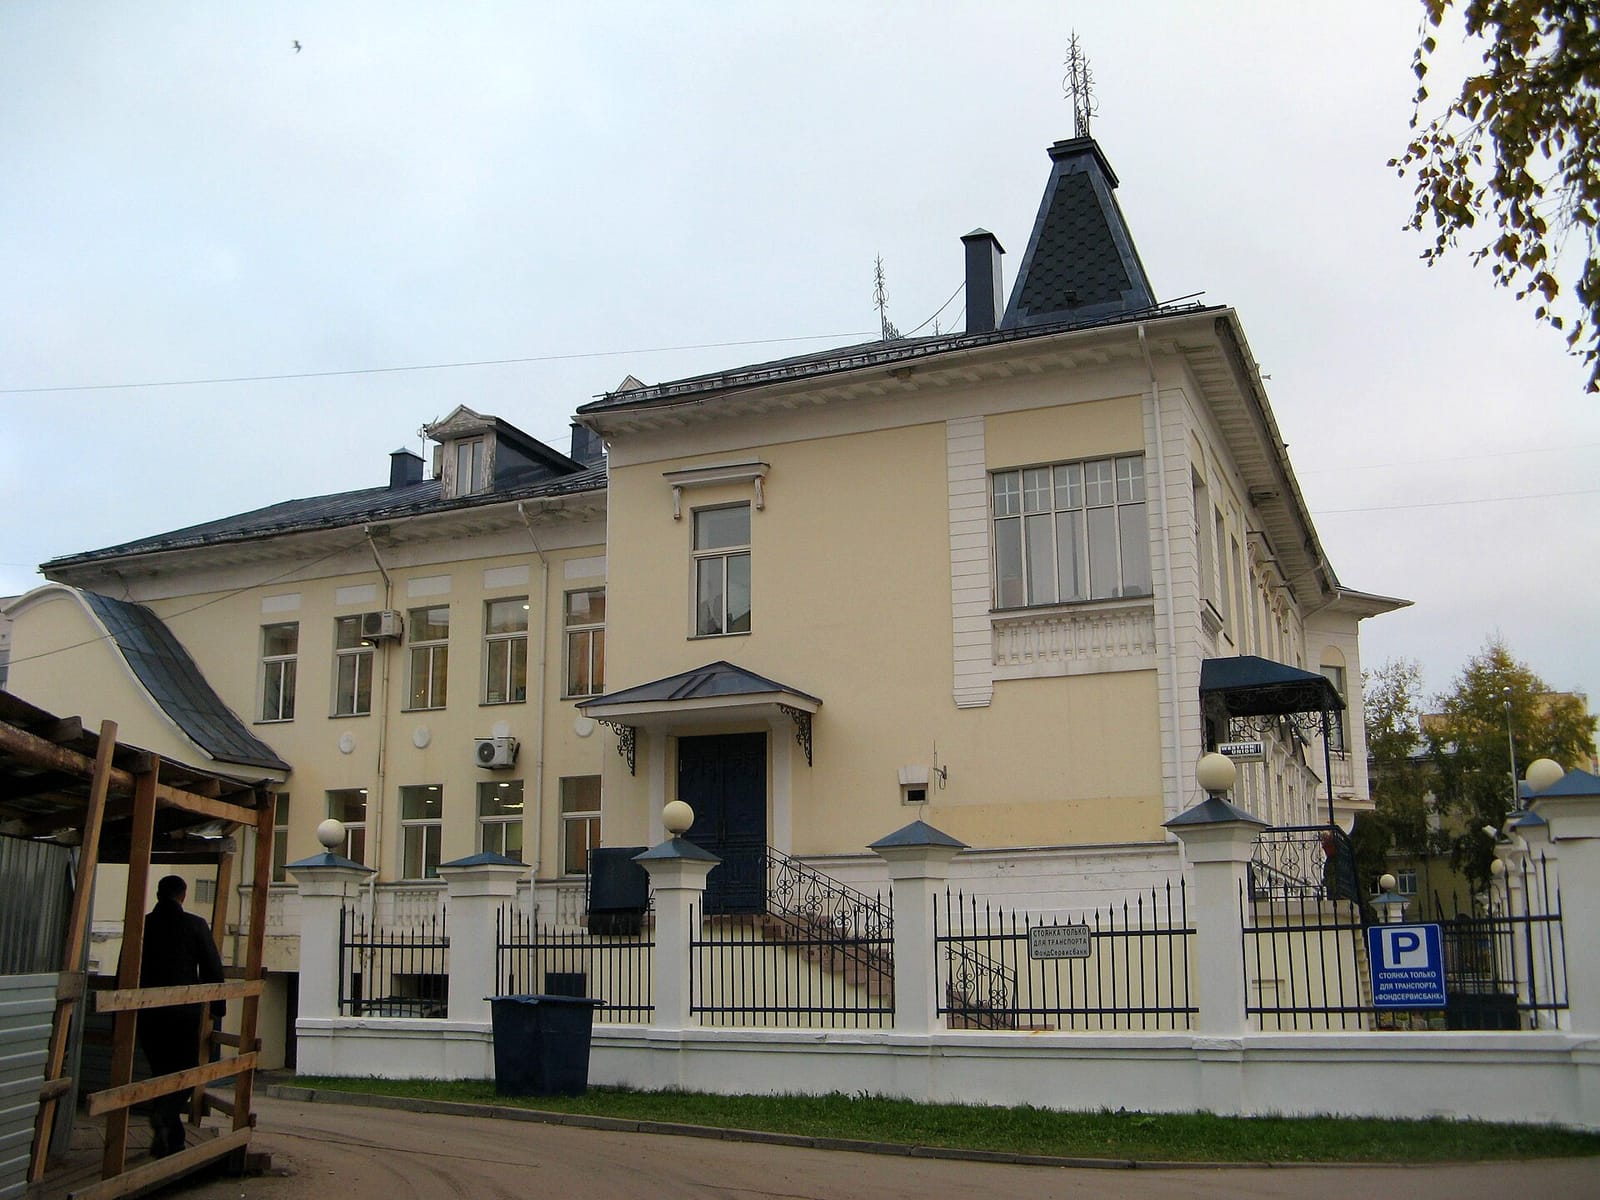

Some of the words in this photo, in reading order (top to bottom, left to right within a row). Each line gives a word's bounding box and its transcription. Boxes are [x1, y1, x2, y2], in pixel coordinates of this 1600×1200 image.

[1063, 928, 1086, 936] ТОЛЬКО
[1378, 971, 1409, 979] СТОЯНКА
[1379, 983, 1394, 991] ДЛЯ
[1395, 982, 1437, 990] ТРАНСПОРТА
